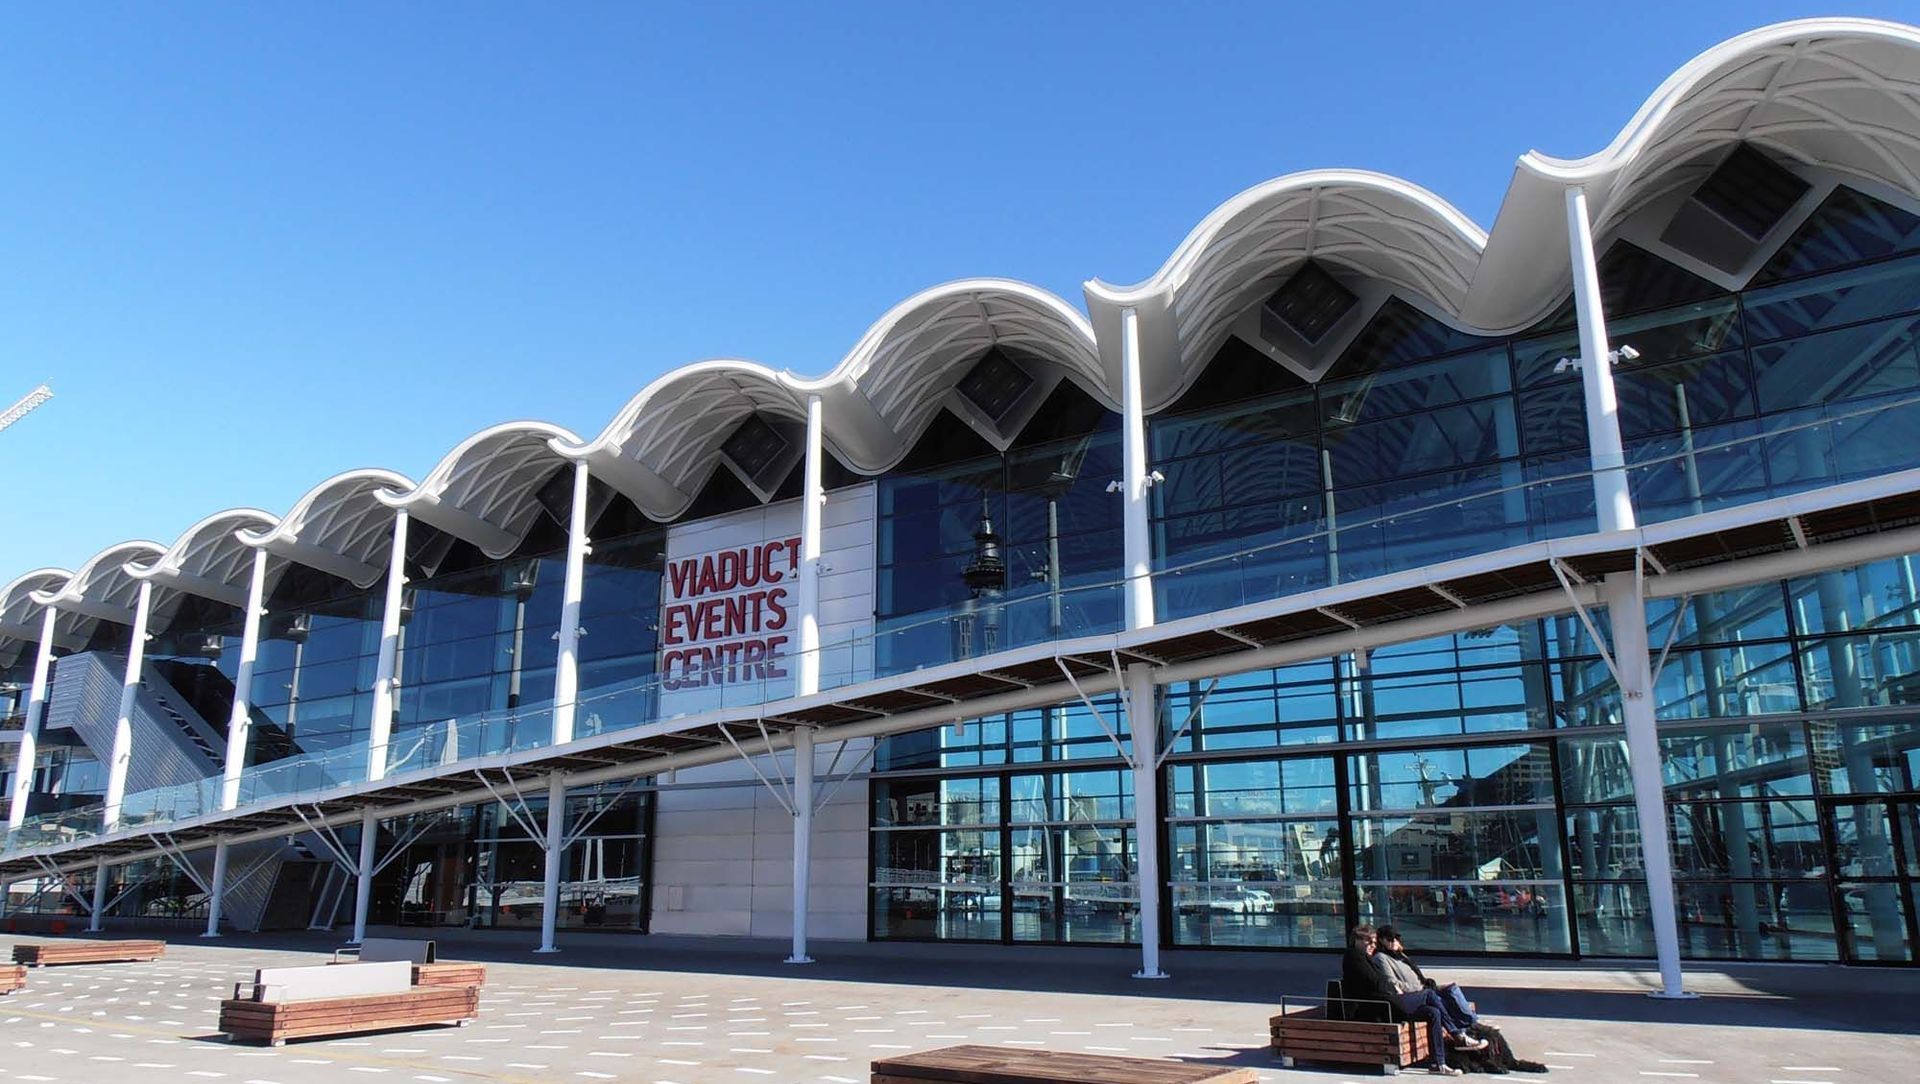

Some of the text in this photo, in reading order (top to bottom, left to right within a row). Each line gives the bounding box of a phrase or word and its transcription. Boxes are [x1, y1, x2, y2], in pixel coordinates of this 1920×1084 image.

[670, 537, 802, 599] VIADUCT
[664, 588, 787, 645] EVENTS
[662, 635, 788, 691] CENTRE
